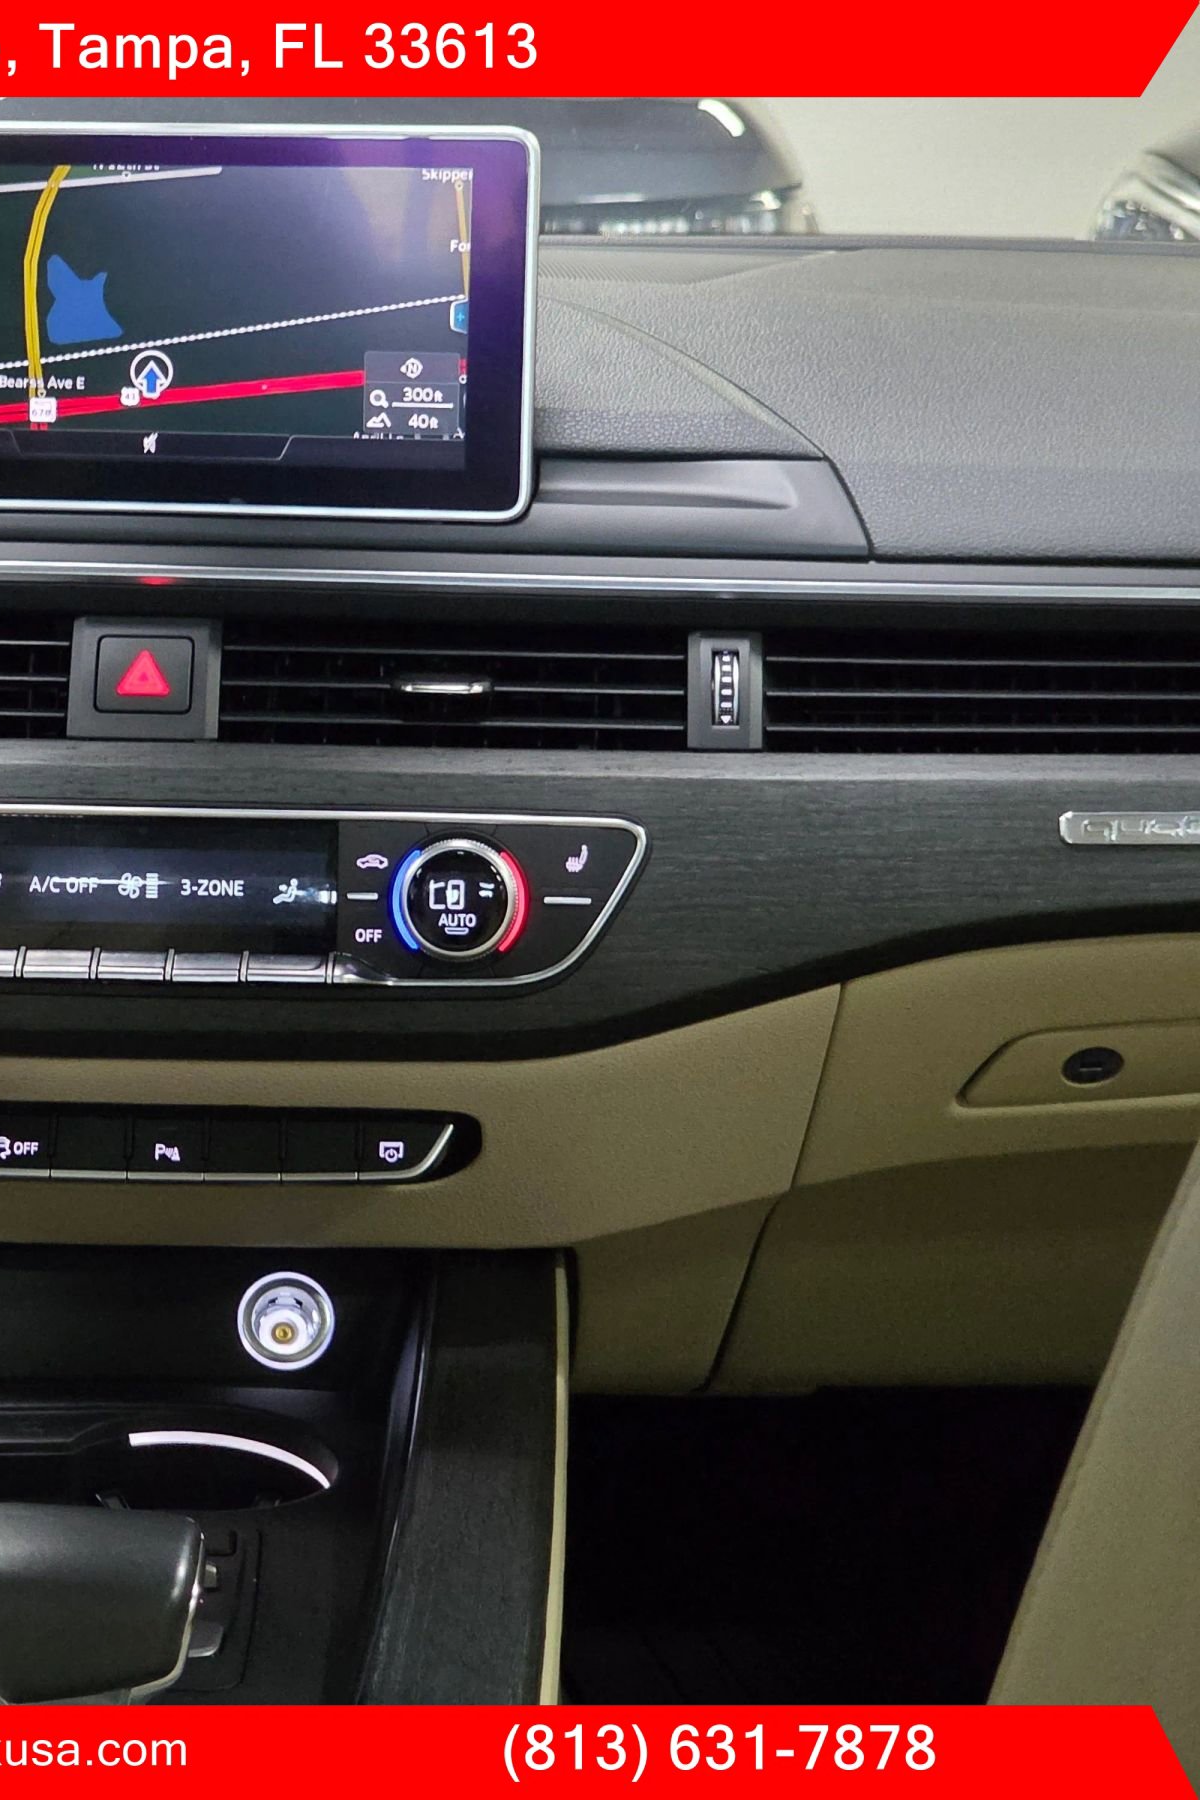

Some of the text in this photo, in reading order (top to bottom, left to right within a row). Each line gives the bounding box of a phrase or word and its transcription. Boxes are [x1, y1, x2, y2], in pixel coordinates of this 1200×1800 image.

[46, 375, 73, 390] Ave
[76, 376, 85, 390] E
[28, 875, 98, 894] A/C OFF
[180, 878, 245, 897] 3-ZONE
[438, 913, 478, 928] AUTO
[355, 928, 383, 943] OFF
[13, 1141, 39, 1156] OFF
